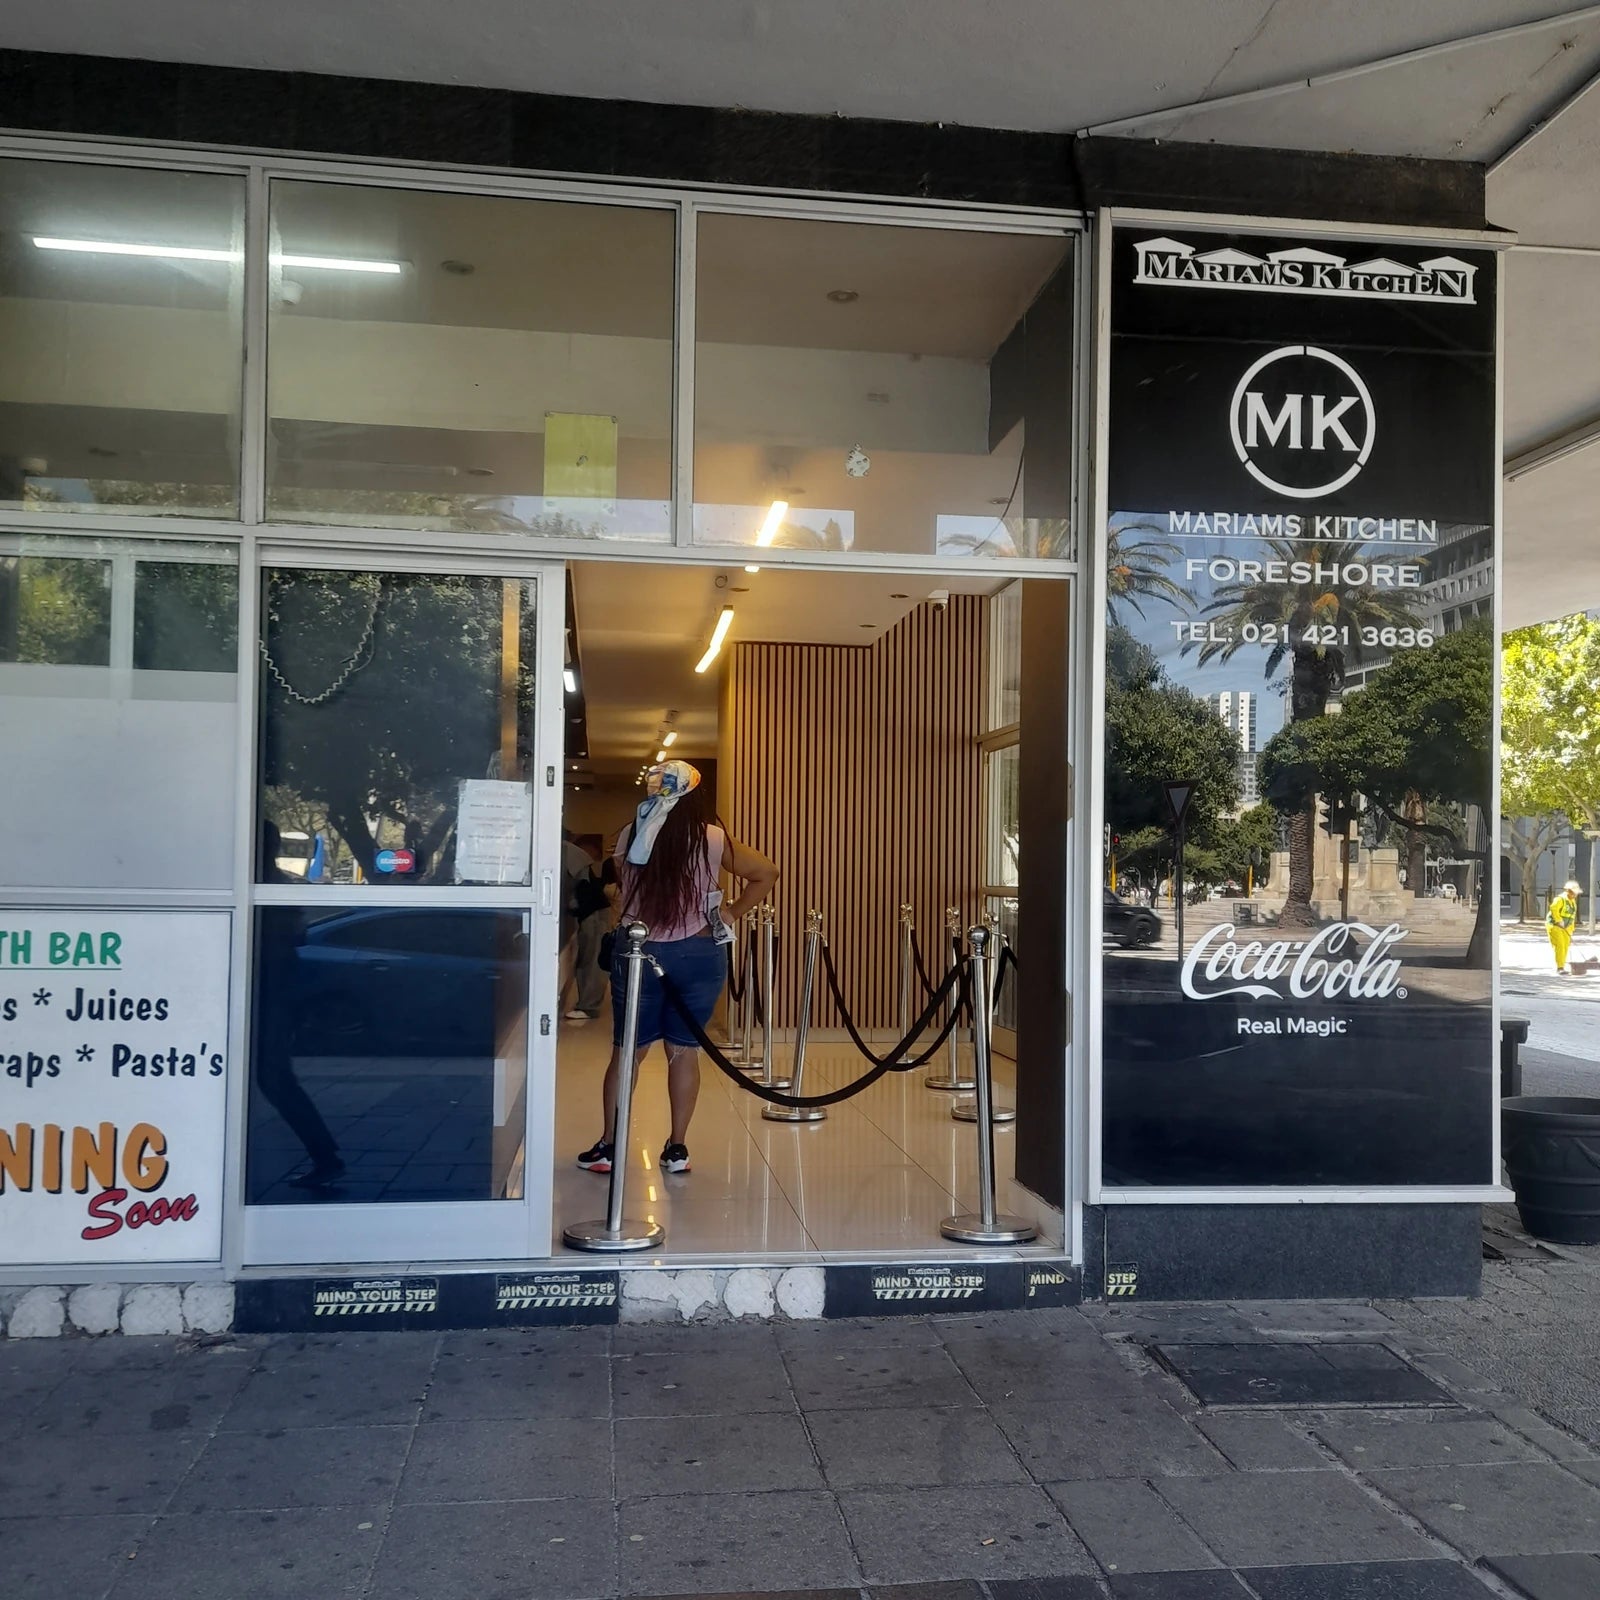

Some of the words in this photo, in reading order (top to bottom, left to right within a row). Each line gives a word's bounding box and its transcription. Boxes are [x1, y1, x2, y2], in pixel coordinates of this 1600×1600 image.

[1245, 391, 1361, 452] MK
[1169, 510, 1302, 538] MARIAMS
[1314, 515, 1437, 542] KITCHEN
[1186, 558, 1421, 588] FORESHORE
[1170, 620, 1233, 643] TEL:
[1242, 623, 1291, 645] 021
[1302, 624, 1350, 646] 421
[1361, 626, 1435, 648] 3636
[49, 931, 122, 967] BAR
[1180, 922, 1410, 1000] Coca-Cola
[66, 987, 169, 1021] Juices
[1237, 1017, 1282, 1034] Real
[1287, 1016, 1347, 1037] Magic
[112, 1043, 223, 1078] Pasta's
[81, 1188, 199, 1240] Soon
[498, 1285, 538, 1297] MIND
[541, 1283, 580, 1295] YOUR
[584, 1282, 615, 1294] STEP
[875, 1277, 911, 1288] MIND
[914, 1276, 951, 1288] YOUR
[954, 1276, 983, 1287] STEP
[1029, 1273, 1065, 1285] MIND
[1108, 1273, 1137, 1284] STEP
[316, 1290, 357, 1303] MIND
[360, 1289, 402, 1301] YOUR
[405, 1288, 437, 1301] STEP
